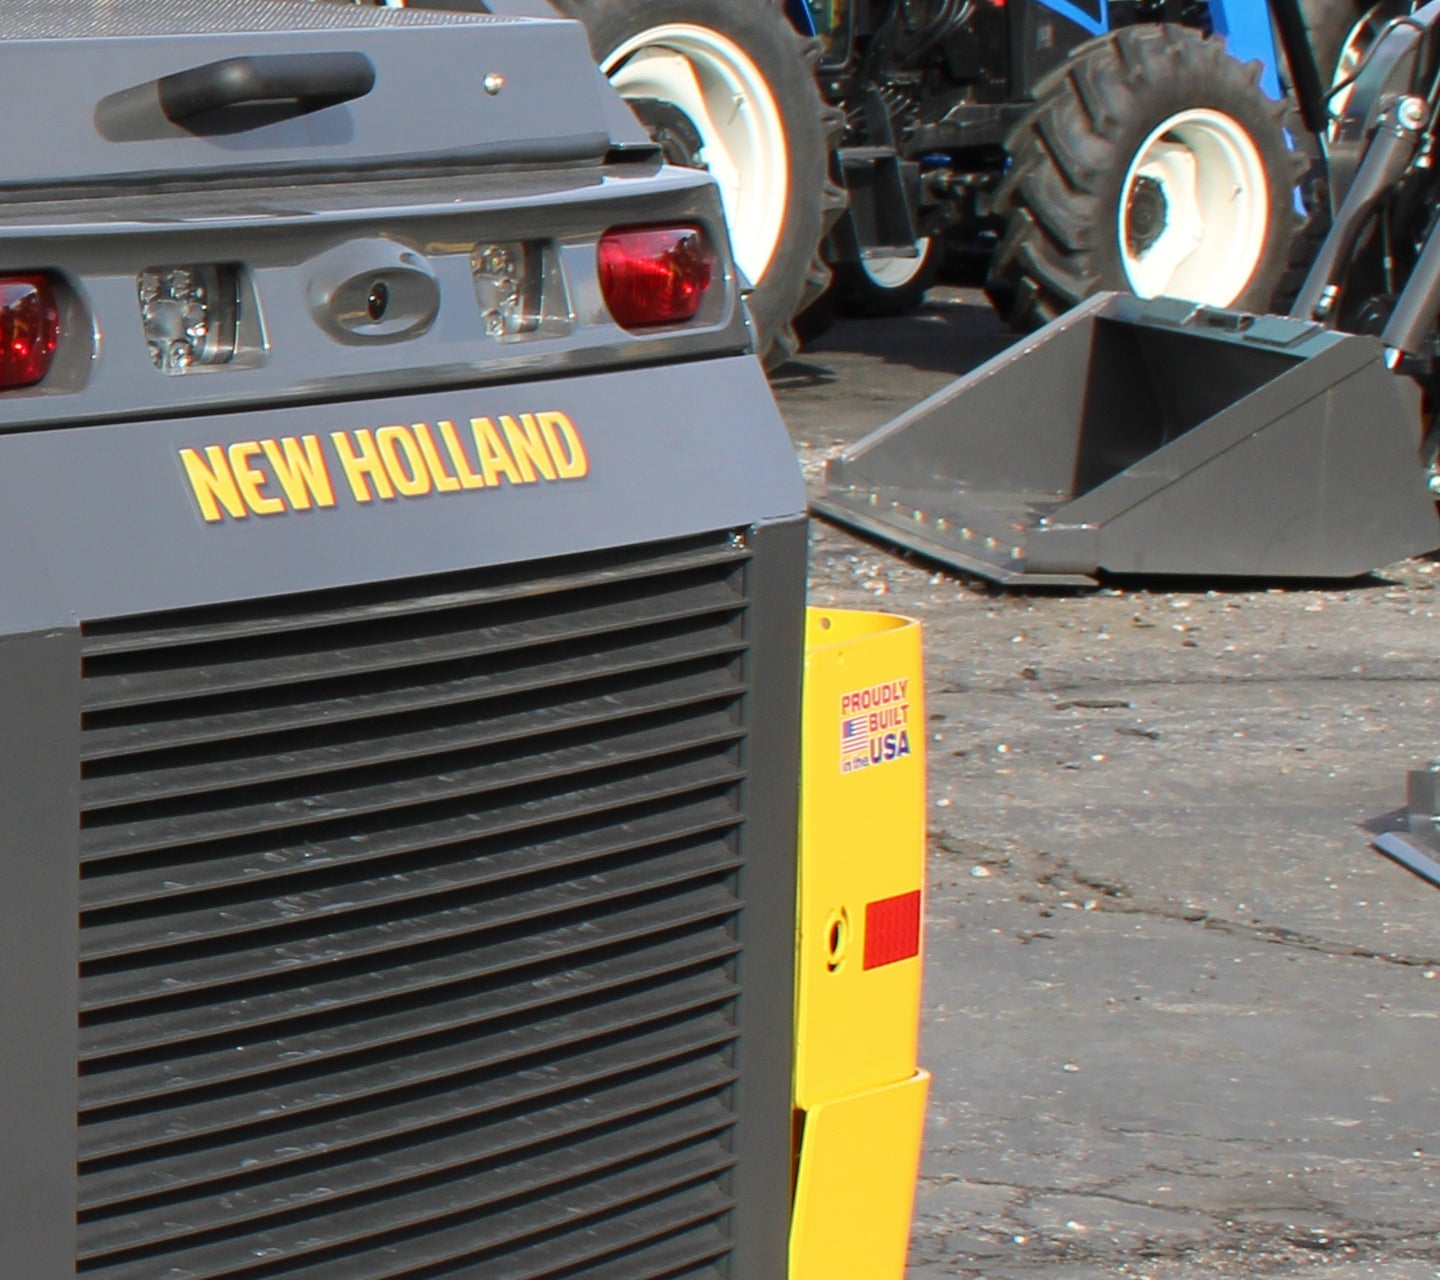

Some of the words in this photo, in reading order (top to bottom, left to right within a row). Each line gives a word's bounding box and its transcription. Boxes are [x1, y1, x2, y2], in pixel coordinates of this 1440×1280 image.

[179, 430, 338, 523] NEW
[330, 410, 587, 504] HOLLAND
[841, 679, 909, 716] PROUDLY
[869, 703, 910, 733] BUILT
[842, 759, 852, 772] in
[853, 755, 869, 770] the
[870, 729, 911, 764] USA
